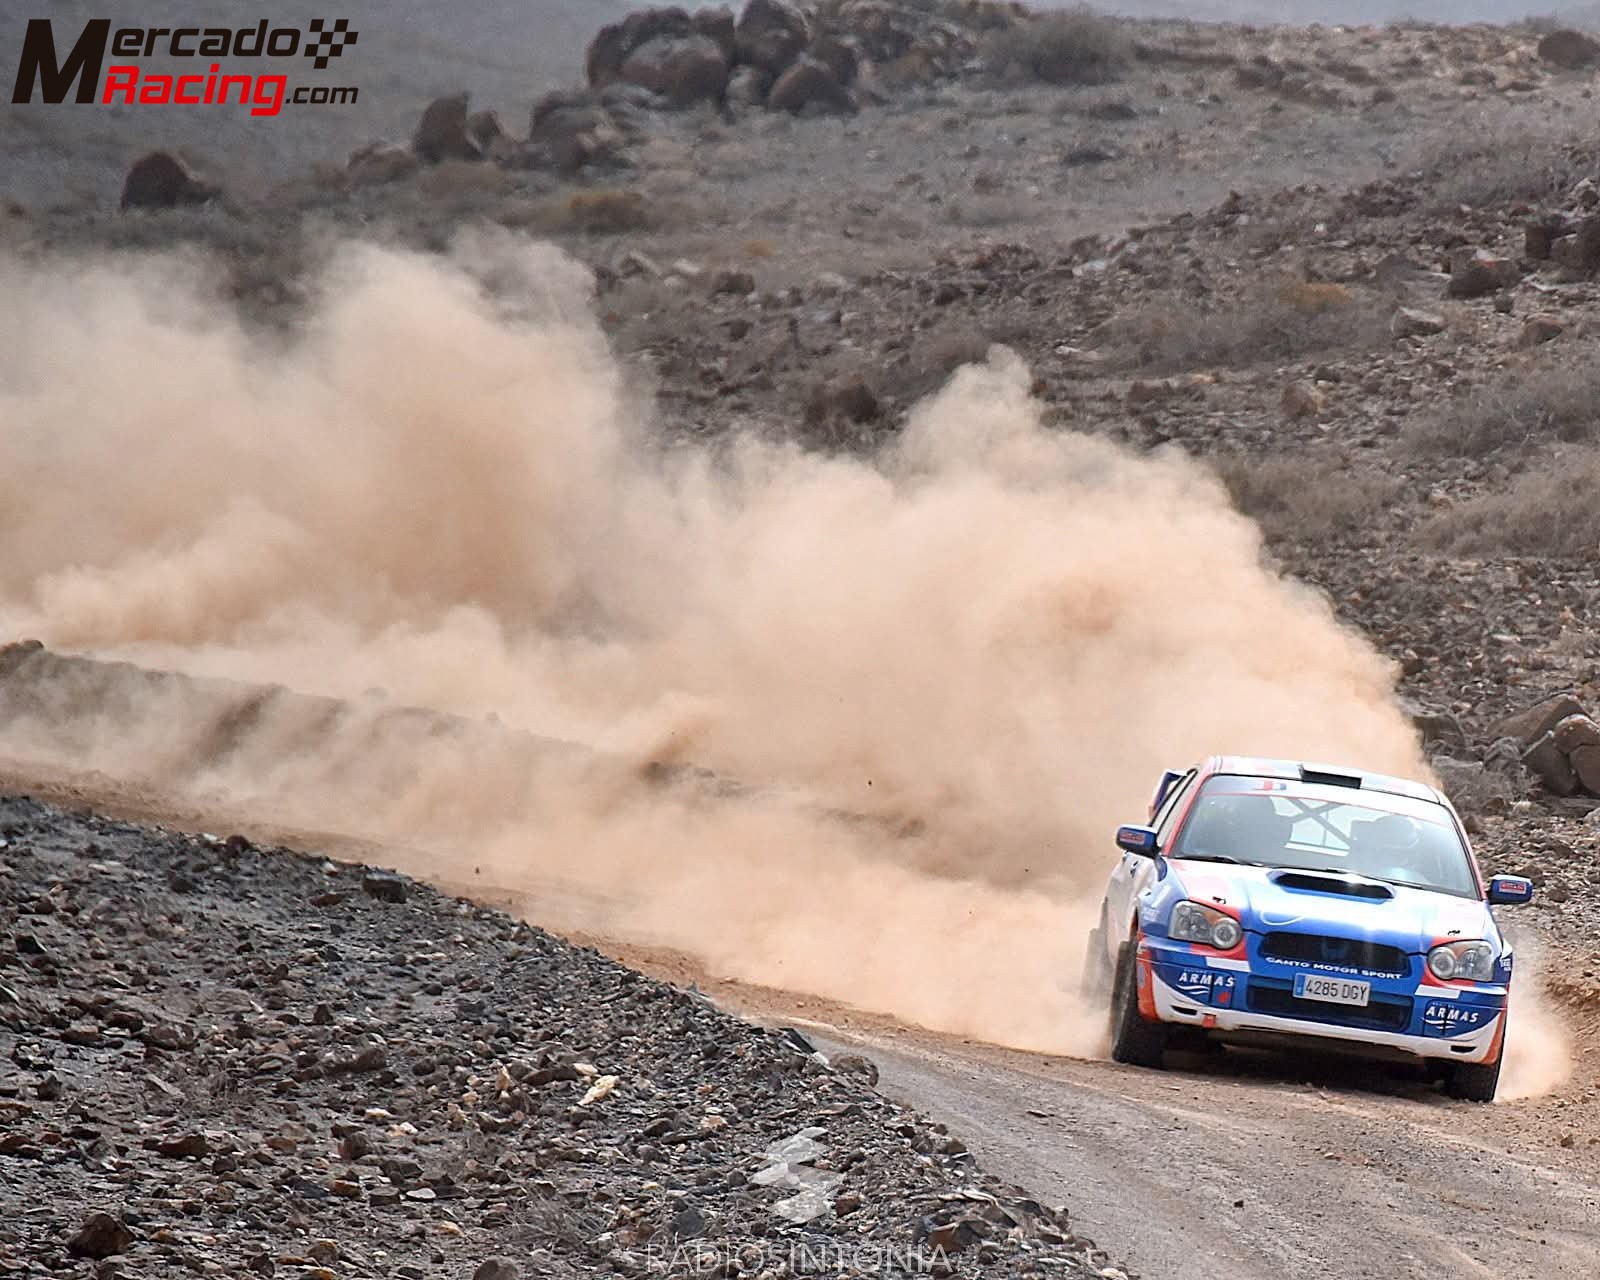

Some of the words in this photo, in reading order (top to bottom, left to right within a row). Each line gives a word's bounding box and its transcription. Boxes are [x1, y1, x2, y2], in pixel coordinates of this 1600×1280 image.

[1265, 956, 1310, 968] CANTO
[1313, 962, 1358, 974] MOTOR
[1361, 969, 1403, 980] SPORT
[1178, 972, 1235, 987] ARMAS
[1305, 979, 1338, 997] 4285
[1341, 984, 1368, 1001] DGY
[1425, 1006, 1479, 1023] ARMAS
